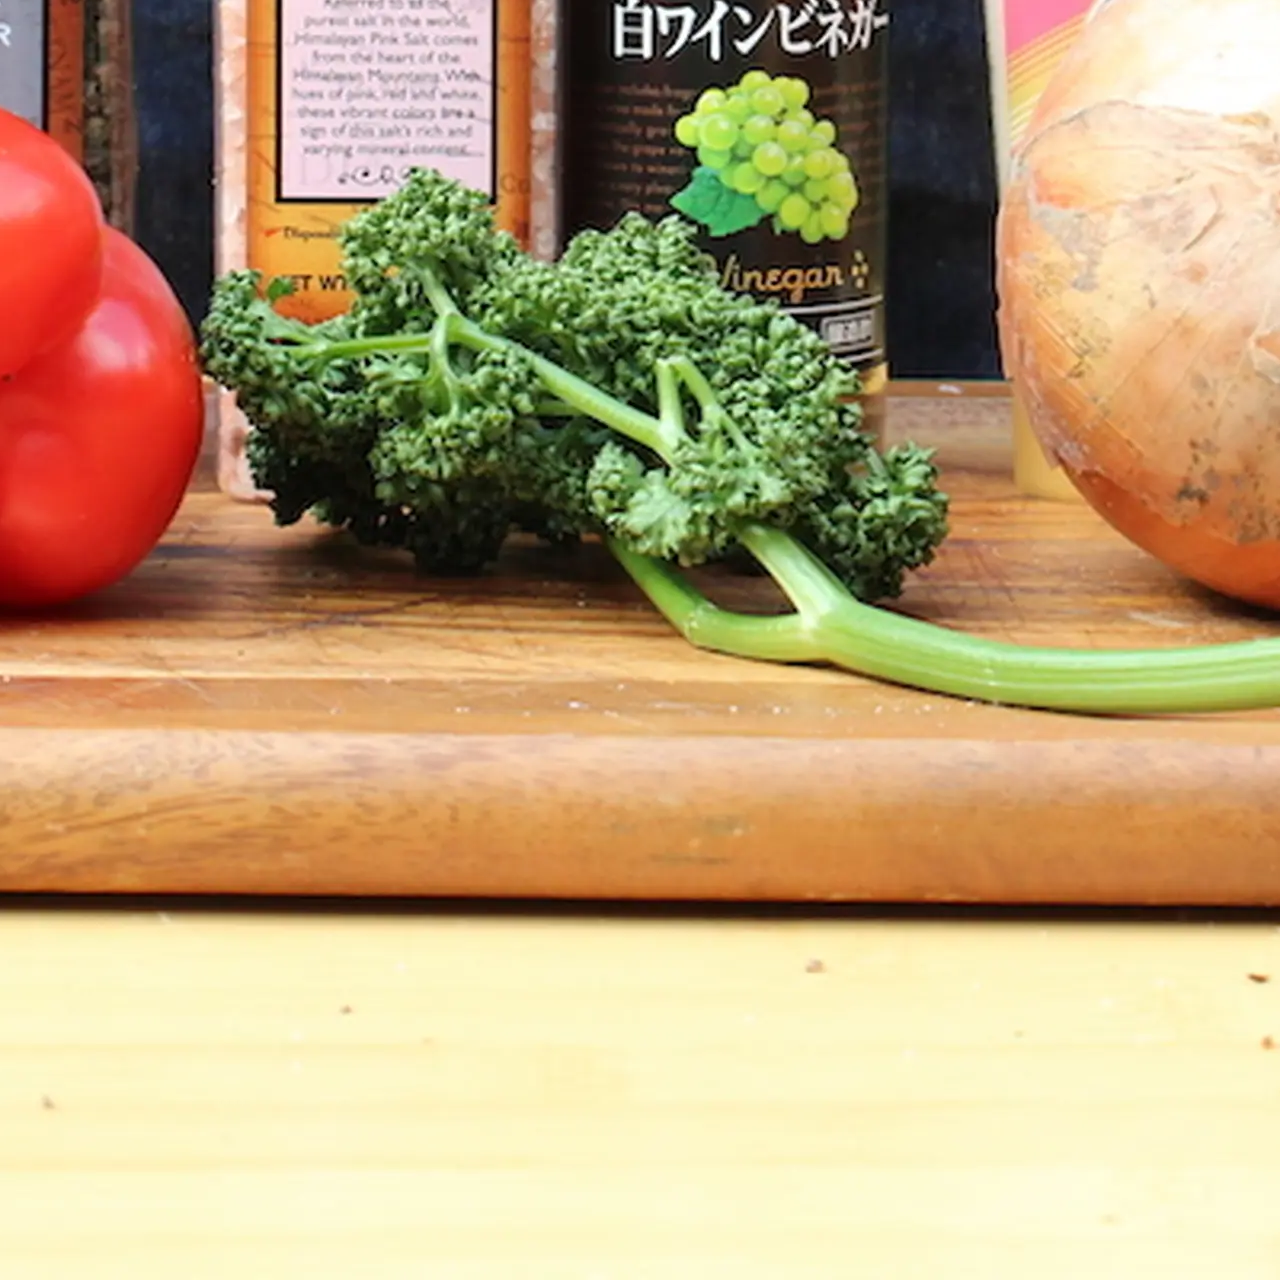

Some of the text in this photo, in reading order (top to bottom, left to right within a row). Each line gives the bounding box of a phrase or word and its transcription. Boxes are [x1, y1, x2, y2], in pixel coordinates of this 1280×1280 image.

[381, 15, 394, 26] in
[398, 15, 420, 26] the
[294, 32, 478, 47] Himalayan Pink Salt comes
[312, 51, 460, 63] from the heart of the
[294, 69, 363, 83] Himalayan
[328, 88, 343, 100] of
[383, 88, 407, 99] red
[411, 88, 435, 99] and
[298, 107, 334, 118] these
[340, 107, 388, 118] vibrant
[392, 107, 435, 119] colors
[301, 126, 326, 139] sign
[331, 125, 346, 137] of
[349, 125, 374, 138] this
[417, 125, 444, 136] rich
[448, 125, 472, 136] and
[304, 145, 353, 158] varying
